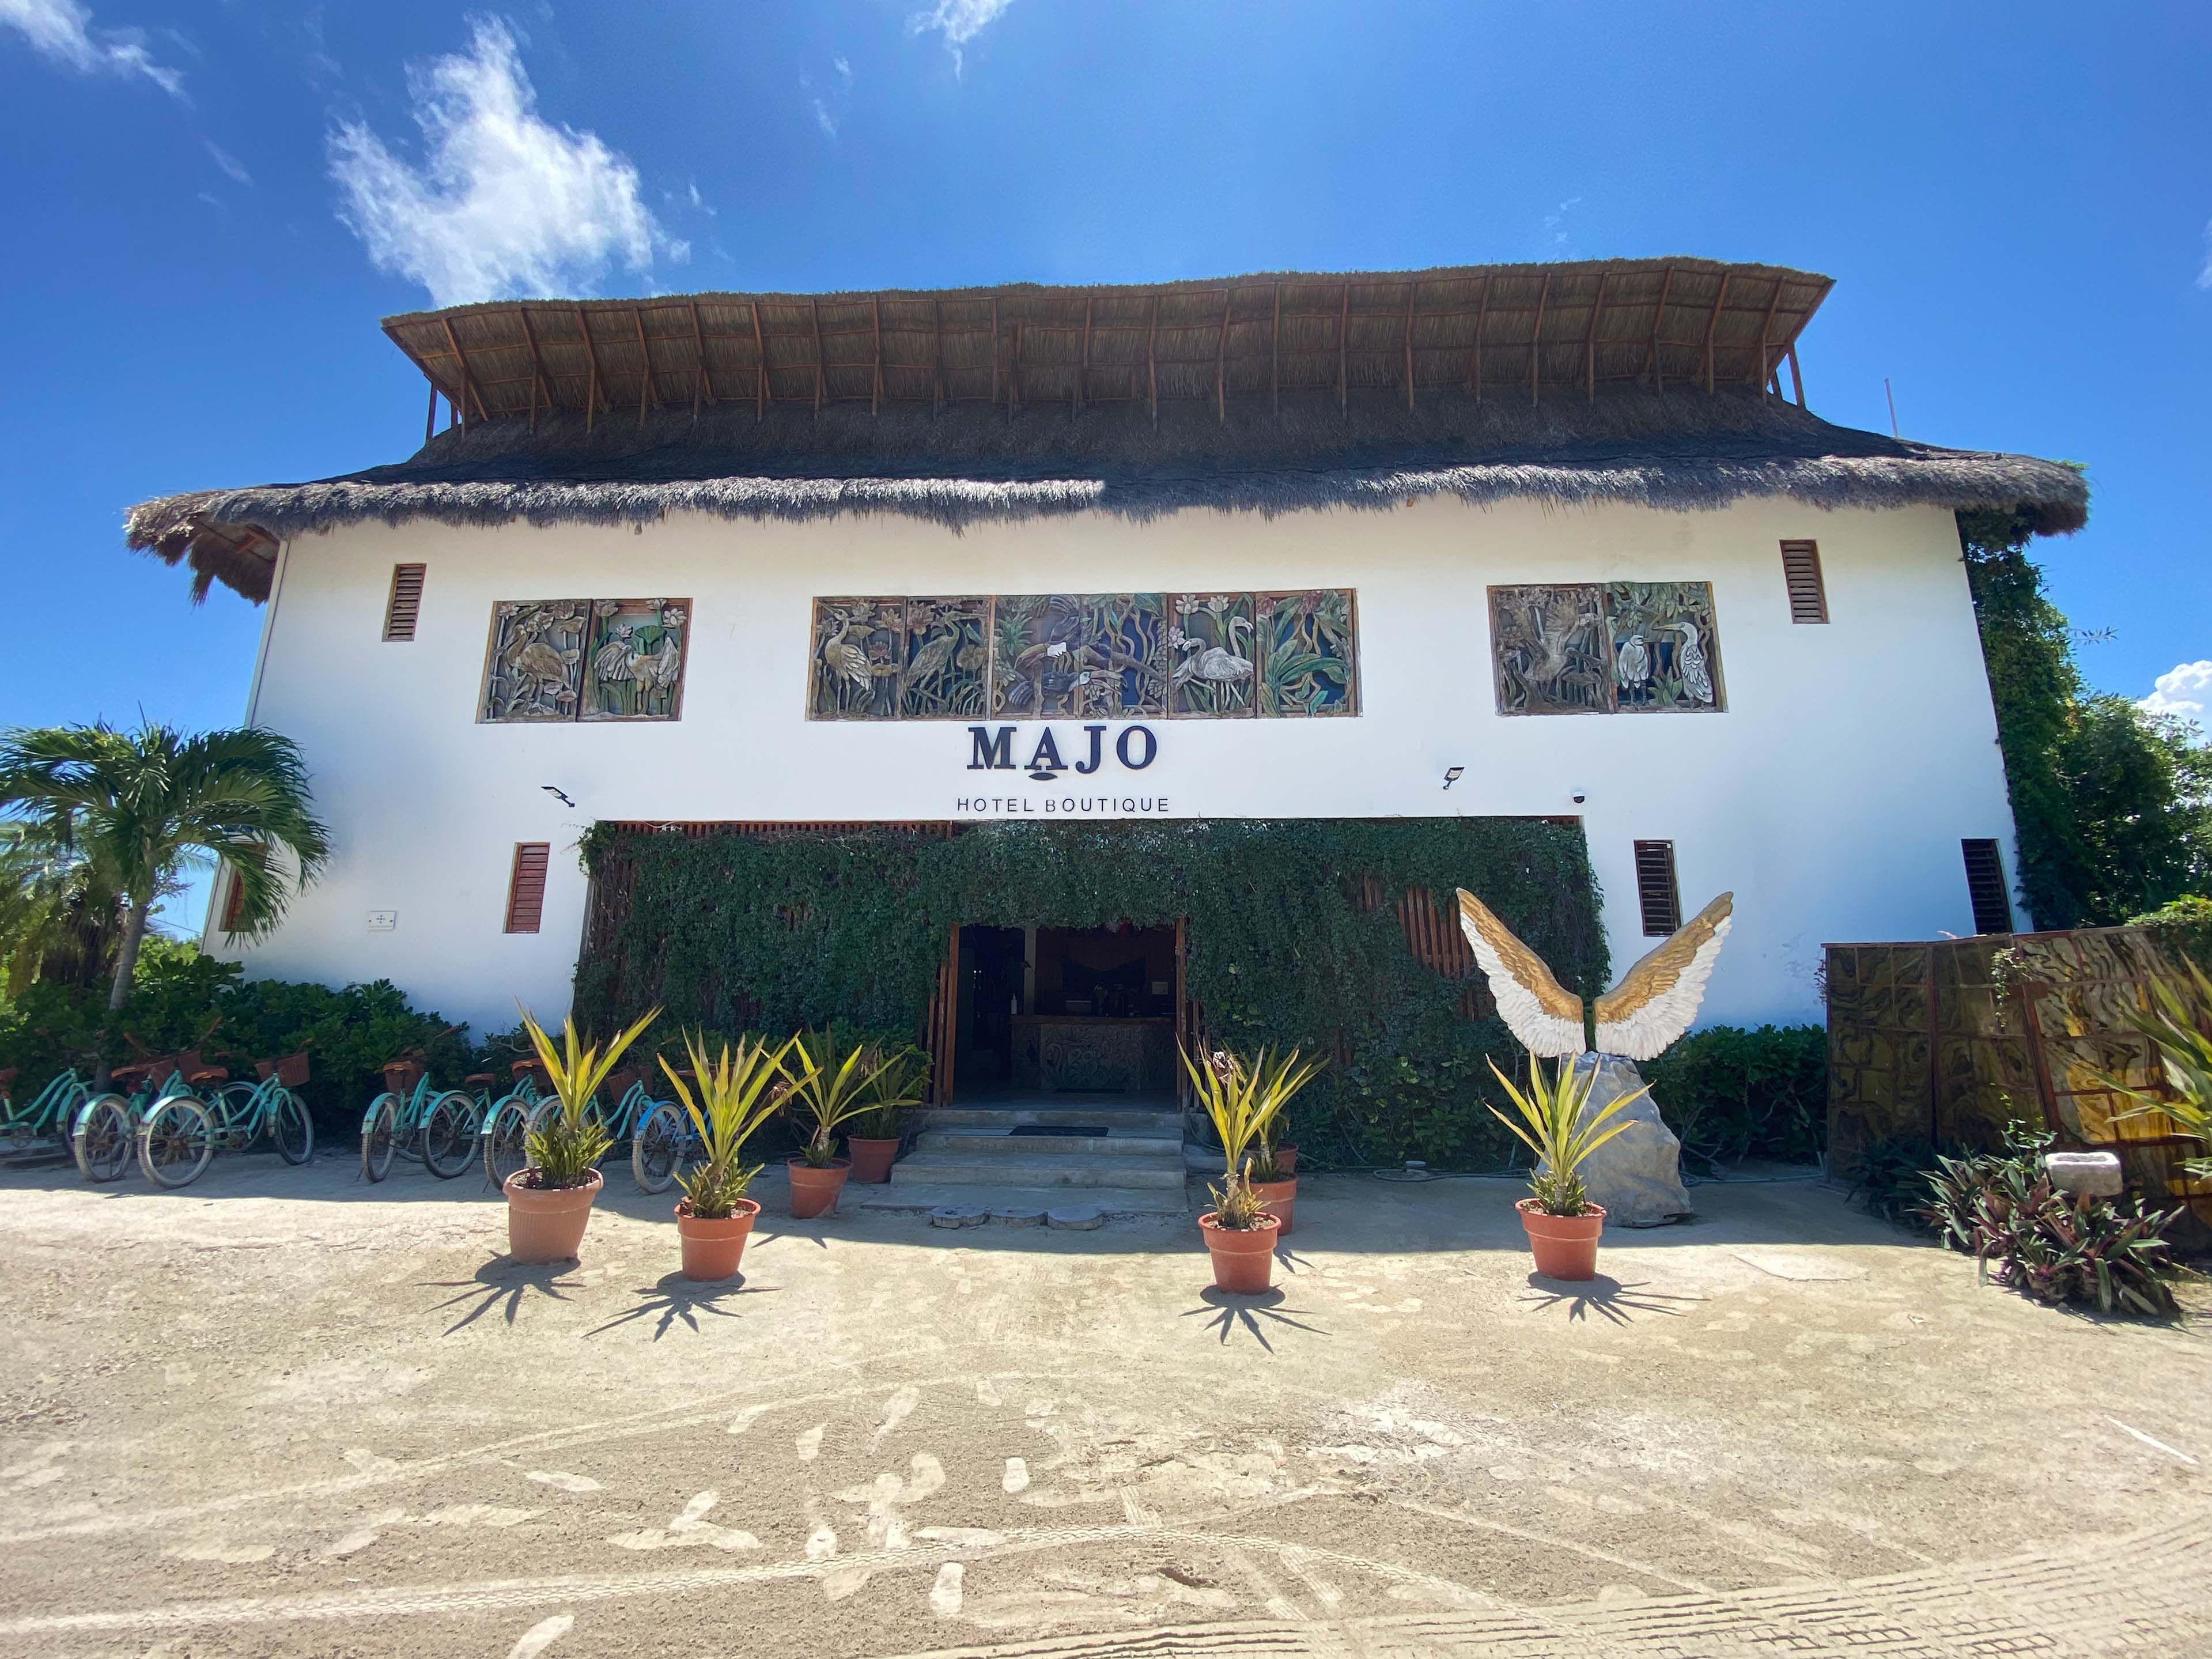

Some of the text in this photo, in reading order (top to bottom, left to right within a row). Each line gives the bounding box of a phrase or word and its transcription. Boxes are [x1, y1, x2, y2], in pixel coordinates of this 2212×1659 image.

[966, 725, 1158, 774] MAJO
[957, 798, 1169, 813] HOTEL BOUTIQUE
